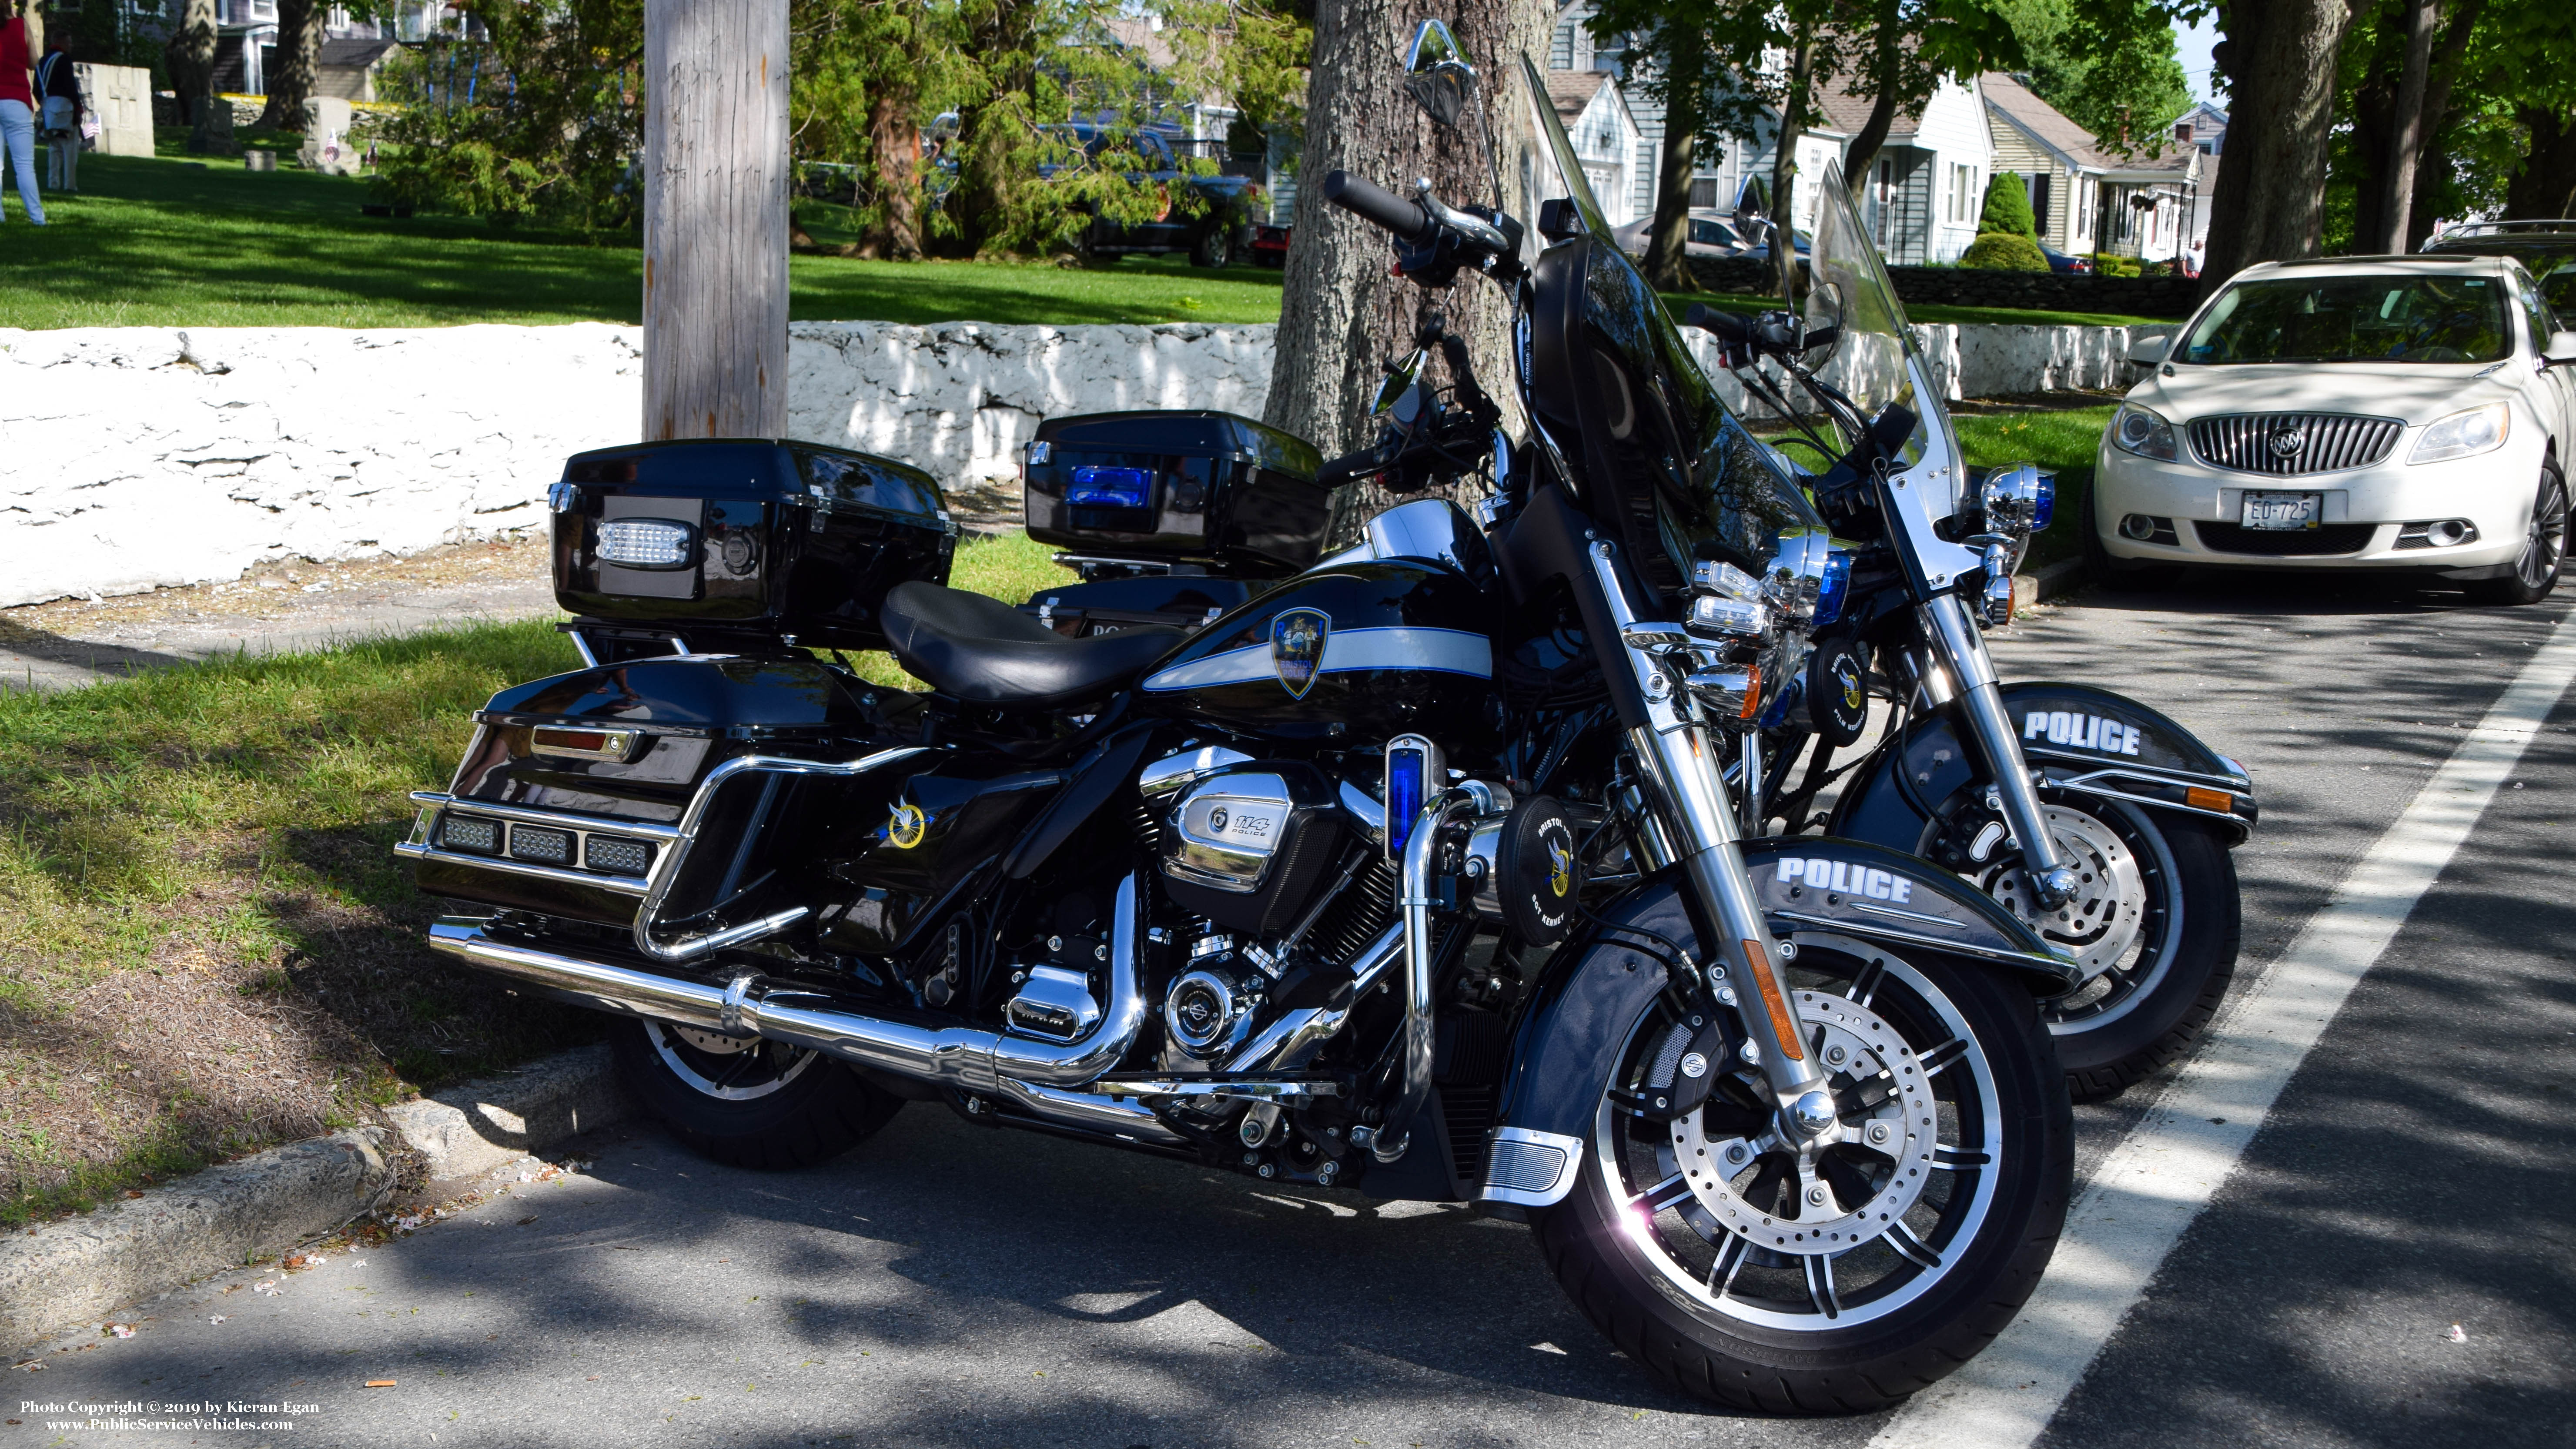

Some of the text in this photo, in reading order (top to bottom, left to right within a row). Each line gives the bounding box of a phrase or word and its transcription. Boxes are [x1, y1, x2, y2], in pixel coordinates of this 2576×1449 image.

[2251, 501, 2310, 520] ED-725
[1275, 620, 1324, 637] R I
[1280, 660, 1313, 669] BRISTOL
[1283, 669, 1311, 677] POLICE
[1831, 653, 1861, 676] BRISTOL POLICE
[2024, 711, 2140, 756] POLICE
[1234, 815, 1270, 831] 114
[1232, 829, 1267, 837] POLICE
[1538, 817, 1574, 862] BRISTOL POLICE
[1776, 857, 1912, 904] POLICE
[1532, 894, 1564, 927] SGT KENNEY
[1038, 1017, 1064, 1026] SPEED
